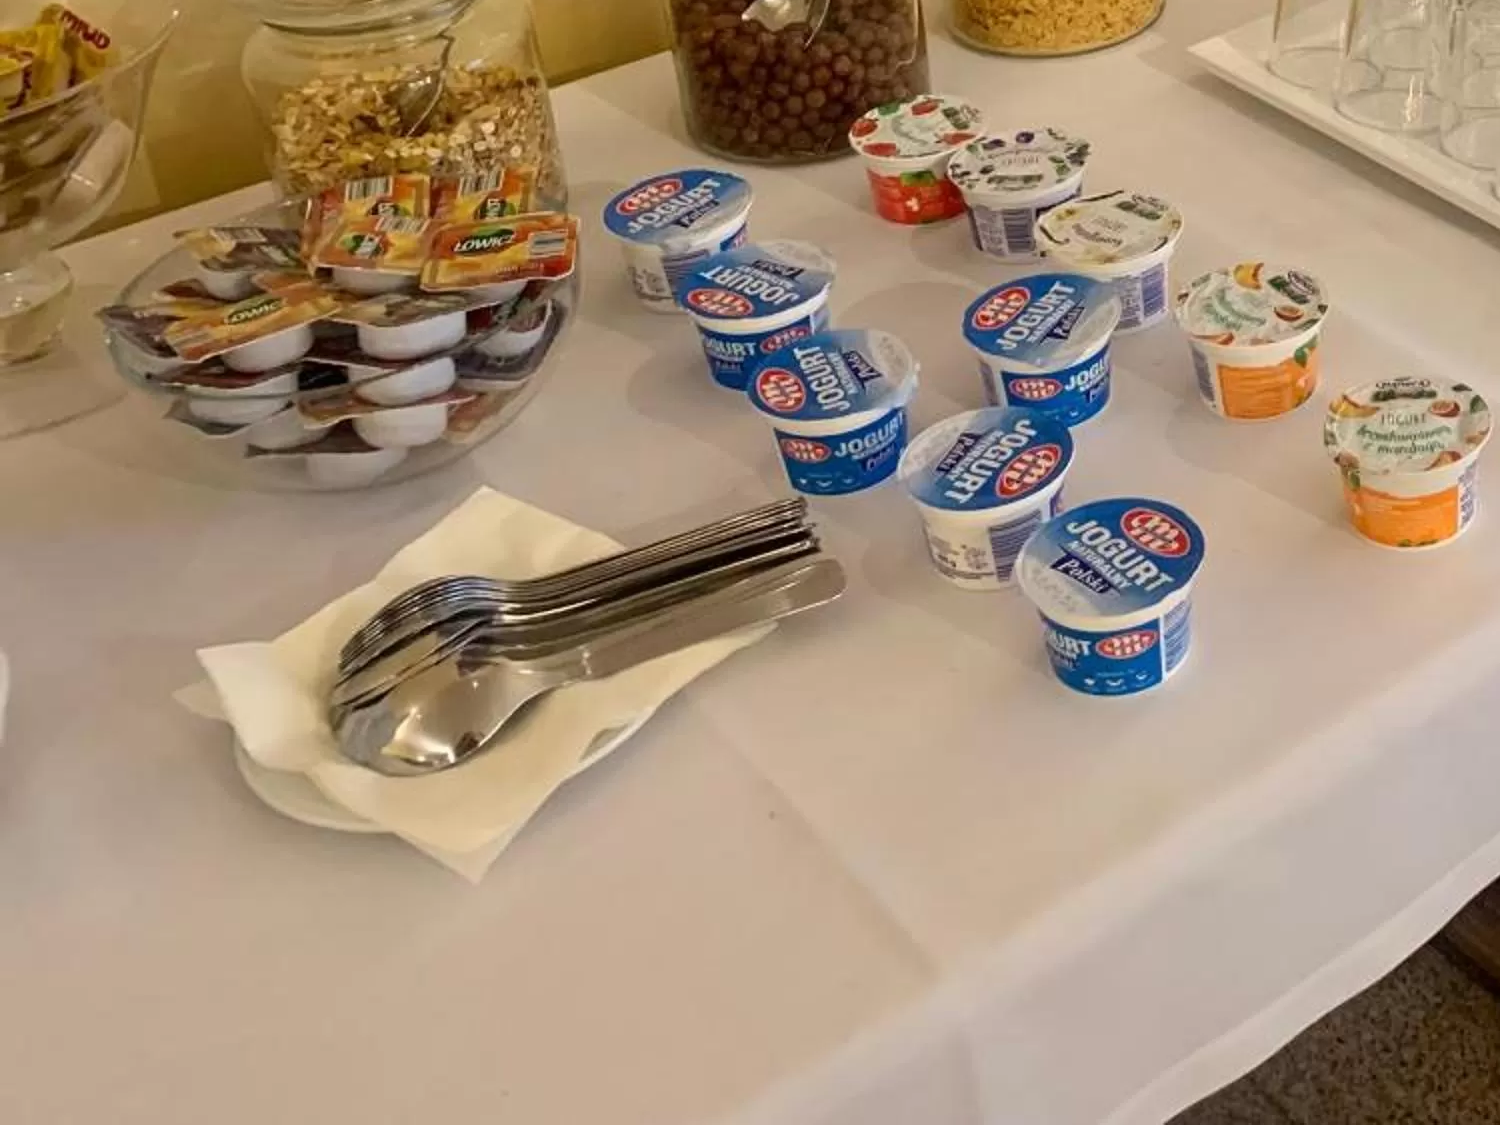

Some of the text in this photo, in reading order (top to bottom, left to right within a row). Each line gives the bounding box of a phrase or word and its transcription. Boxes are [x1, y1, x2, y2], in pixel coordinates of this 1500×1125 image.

[626, 178, 721, 234] JOGURT
[699, 265, 800, 306] JOGURT
[996, 280, 1076, 351] JOGURT
[793, 346, 851, 412] JOGURT
[943, 418, 1038, 504] JOGURT
[1059, 557, 1109, 593] Polski
[1066, 519, 1175, 591] JOGURT
